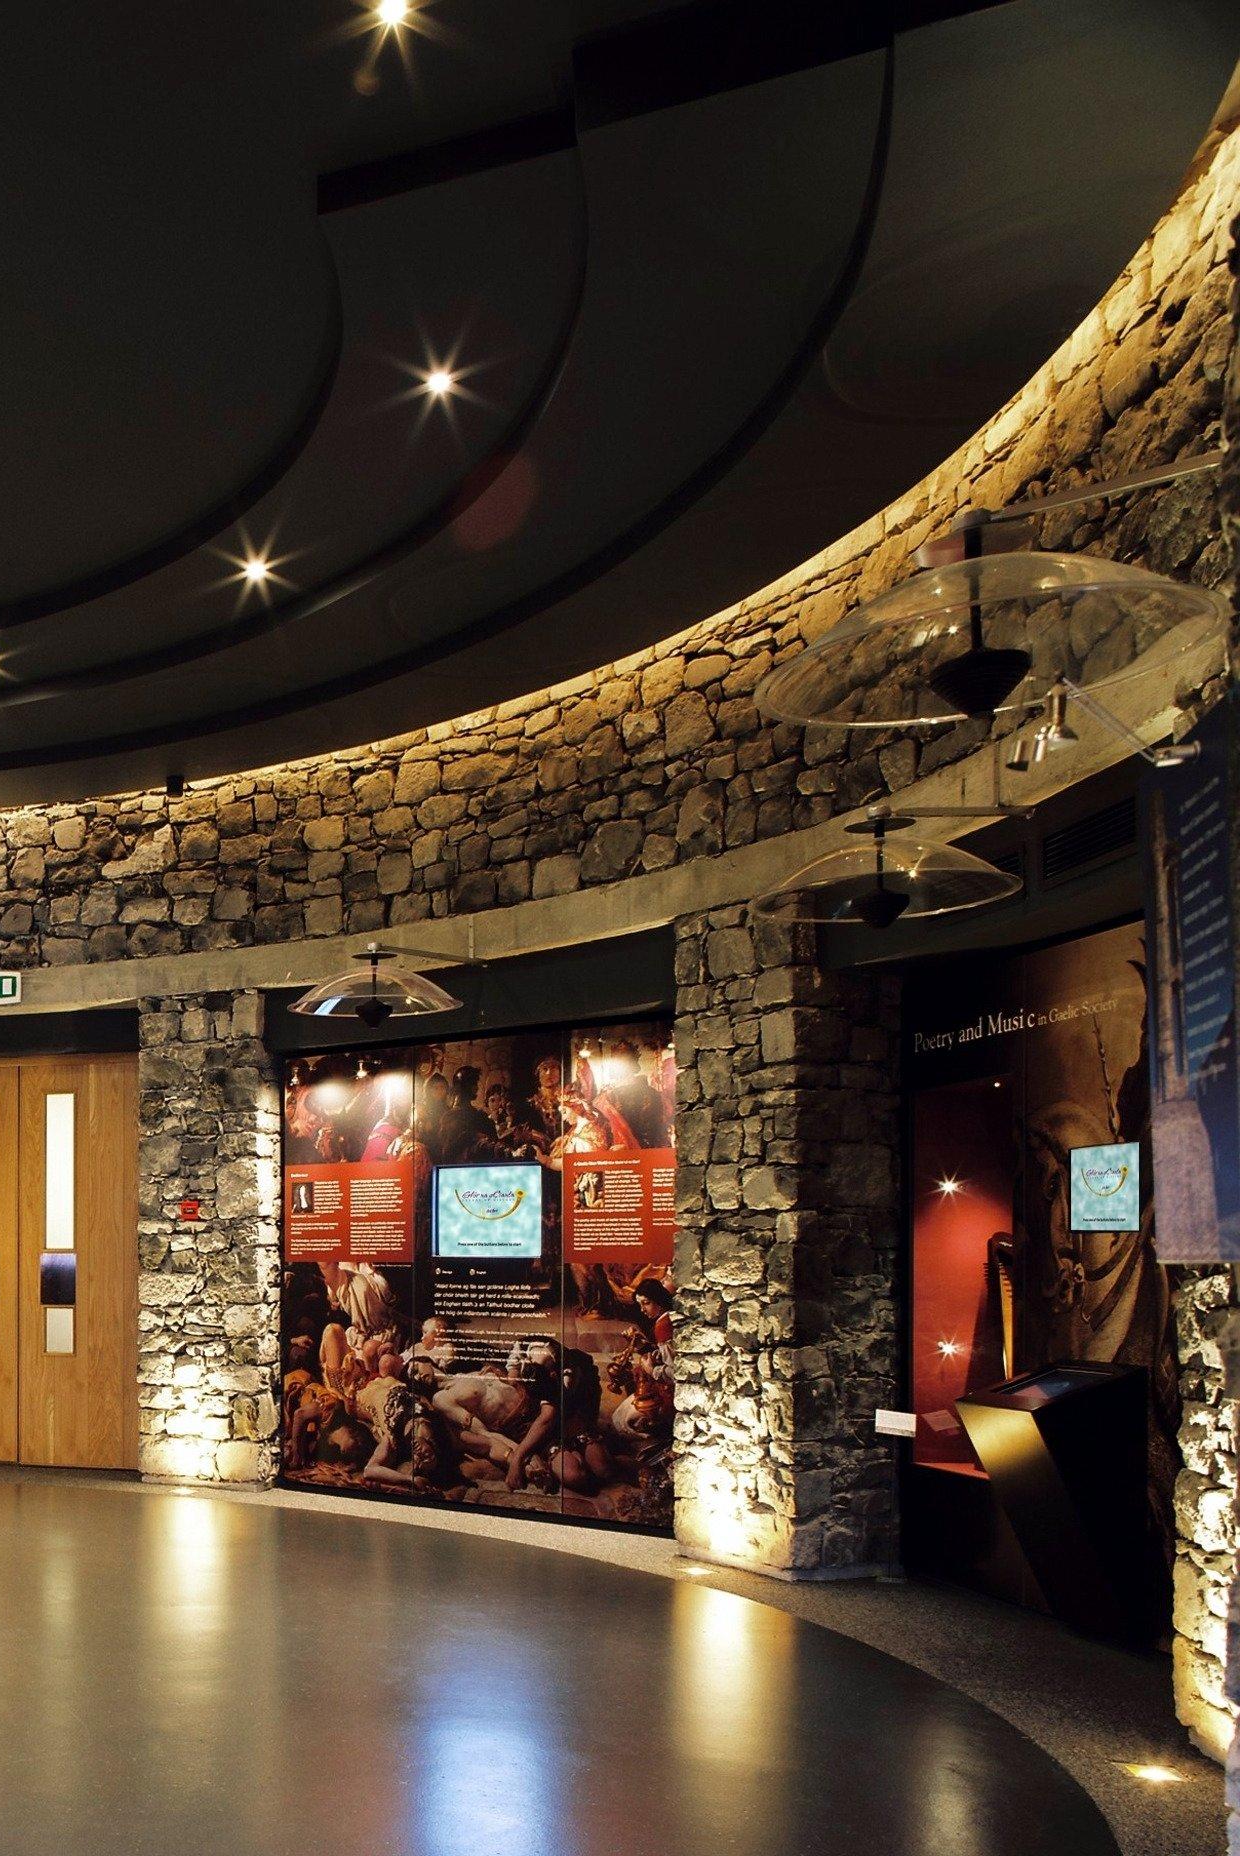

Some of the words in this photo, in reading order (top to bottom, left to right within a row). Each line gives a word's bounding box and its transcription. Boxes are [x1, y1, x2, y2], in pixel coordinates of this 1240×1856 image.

[914, 1031, 955, 1053] Poetry
[959, 1017, 983, 1043] and
[987, 1008, 1035, 1036] Music
[1037, 1015, 1048, 1026] in
[1048, 1004, 1079, 1023] Gaelic
[1081, 998, 1119, 1016] Society
